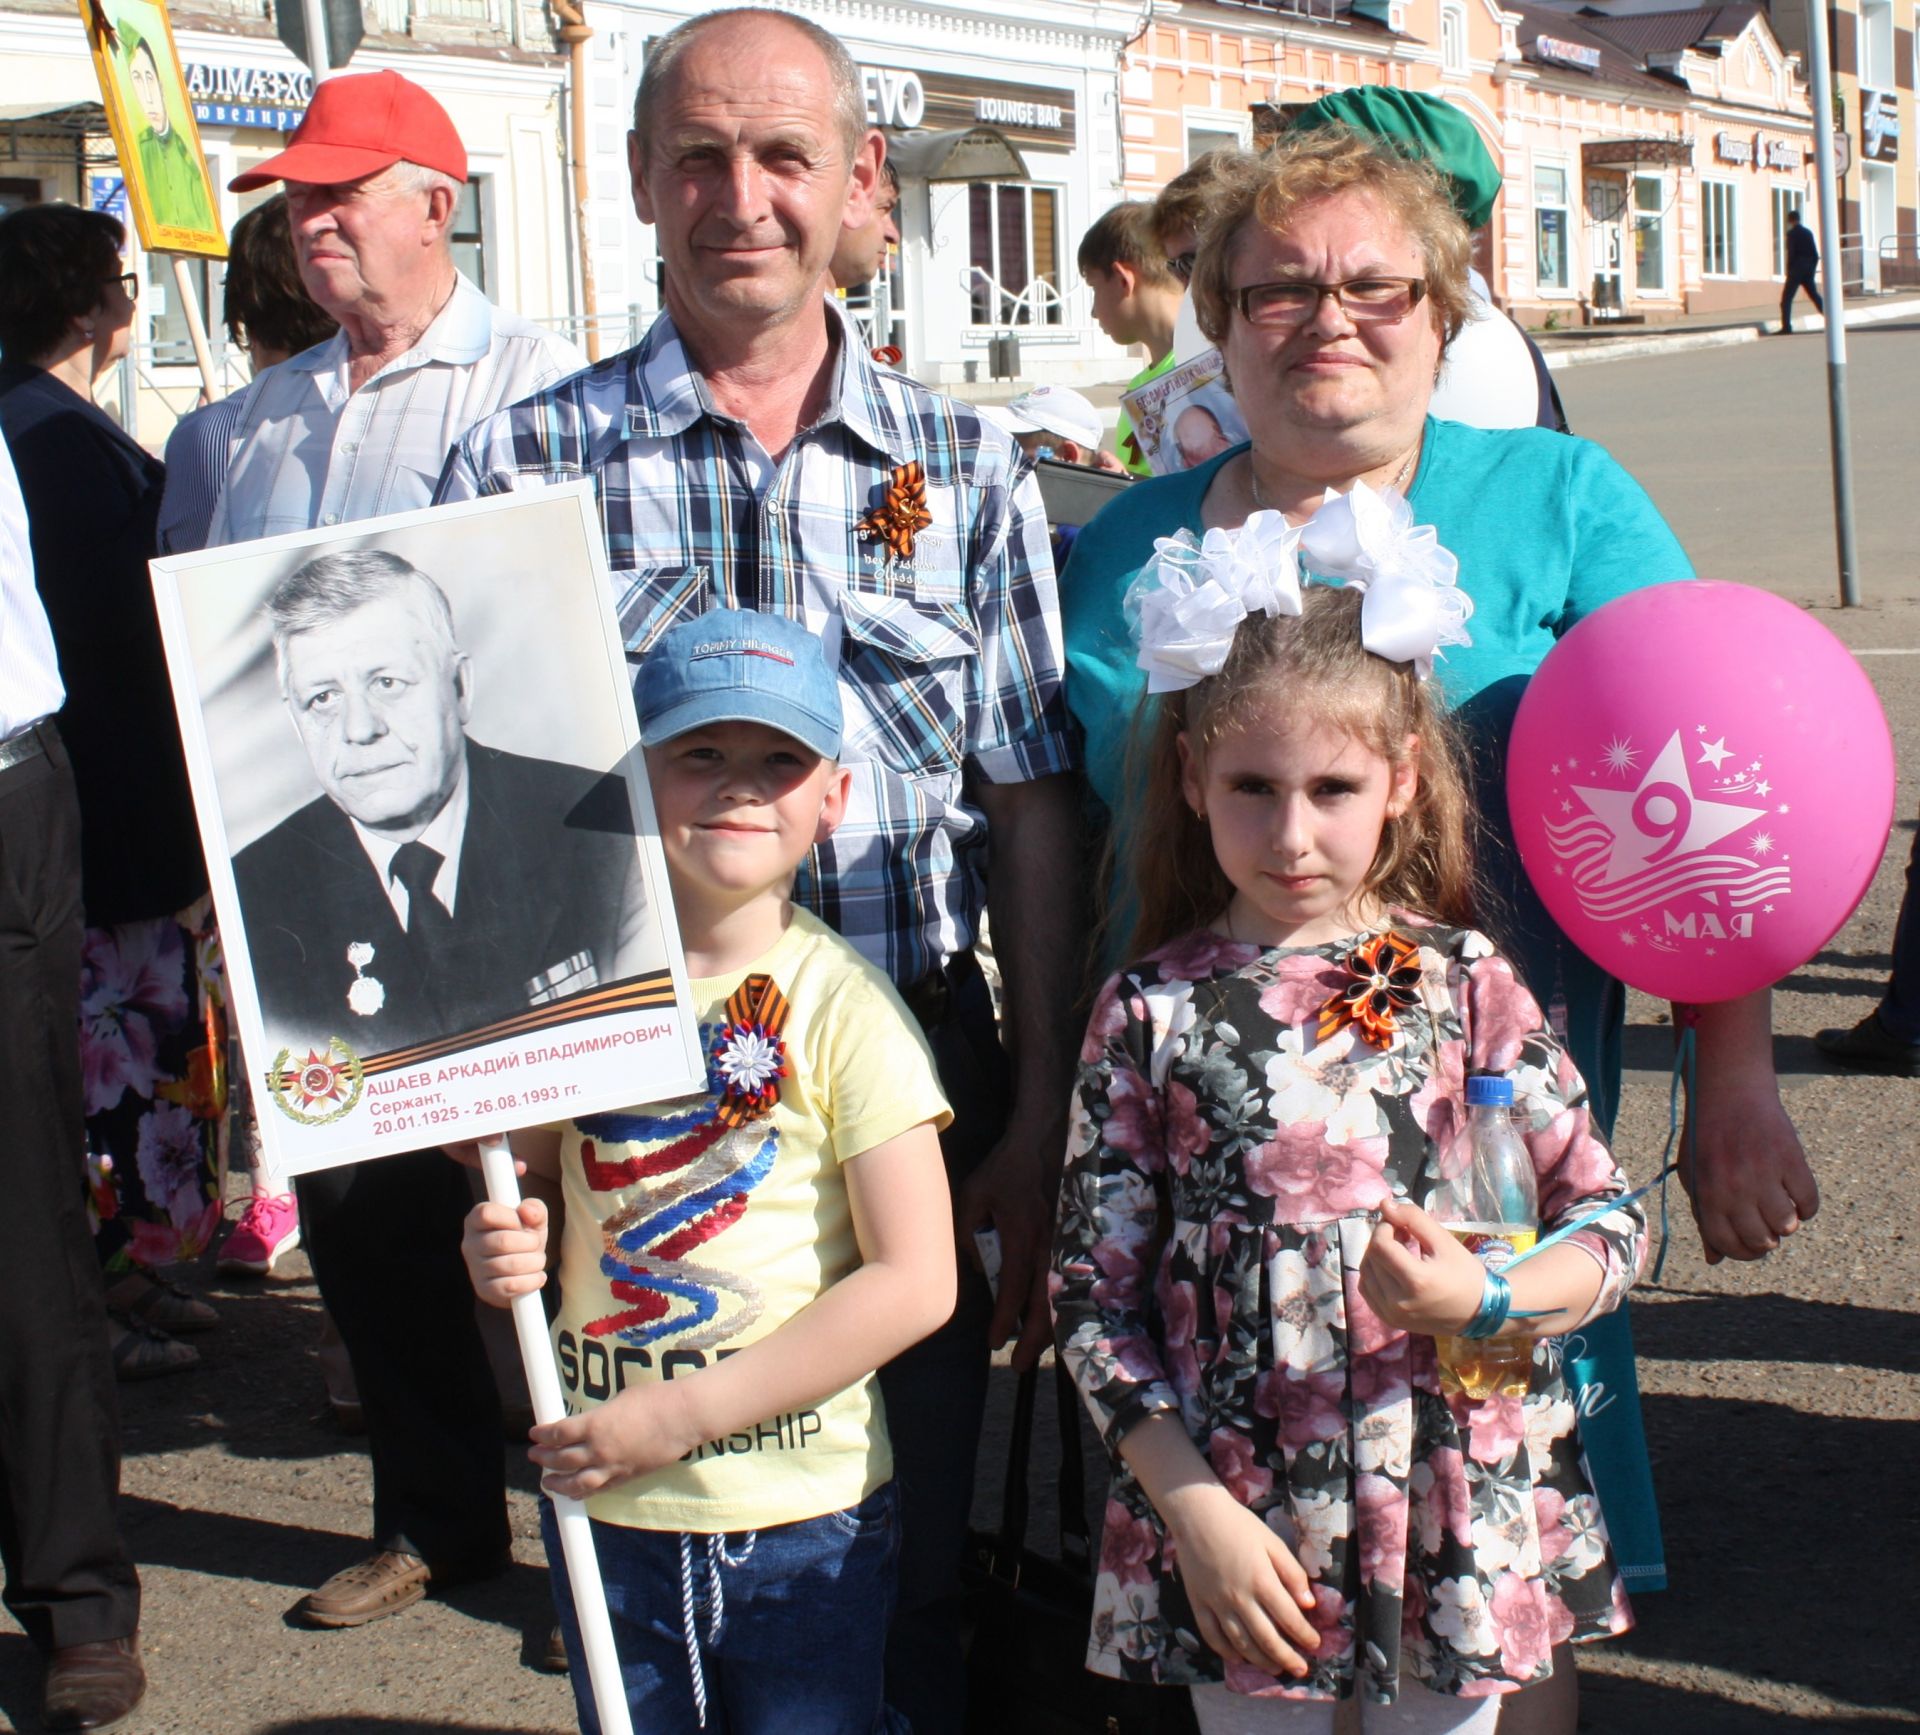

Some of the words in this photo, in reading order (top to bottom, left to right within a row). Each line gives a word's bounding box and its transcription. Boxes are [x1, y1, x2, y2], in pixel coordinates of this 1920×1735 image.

[979, 97, 1035, 125] LOUNGE
[1037, 104, 1063, 127] BAR
[694, 639, 737, 655] TOMMY
[742, 639, 795, 659] HILFIGER
[1632, 782, 1692, 864] 9
[1663, 909, 1754, 941] МАЯ
[367, 1072, 432, 1097] АШАЕВ
[437, 1051, 520, 1083] АРКАДИЙ
[525, 1023, 672, 1065] ВЛАДИМИРОВИЧ
[369, 1092, 447, 1116] Сержант,
[373, 1106, 459, 1135] 20.01.1925
[473, 1085, 559, 1115] 26.08.1993
[564, 1083, 582, 1097] гг.
